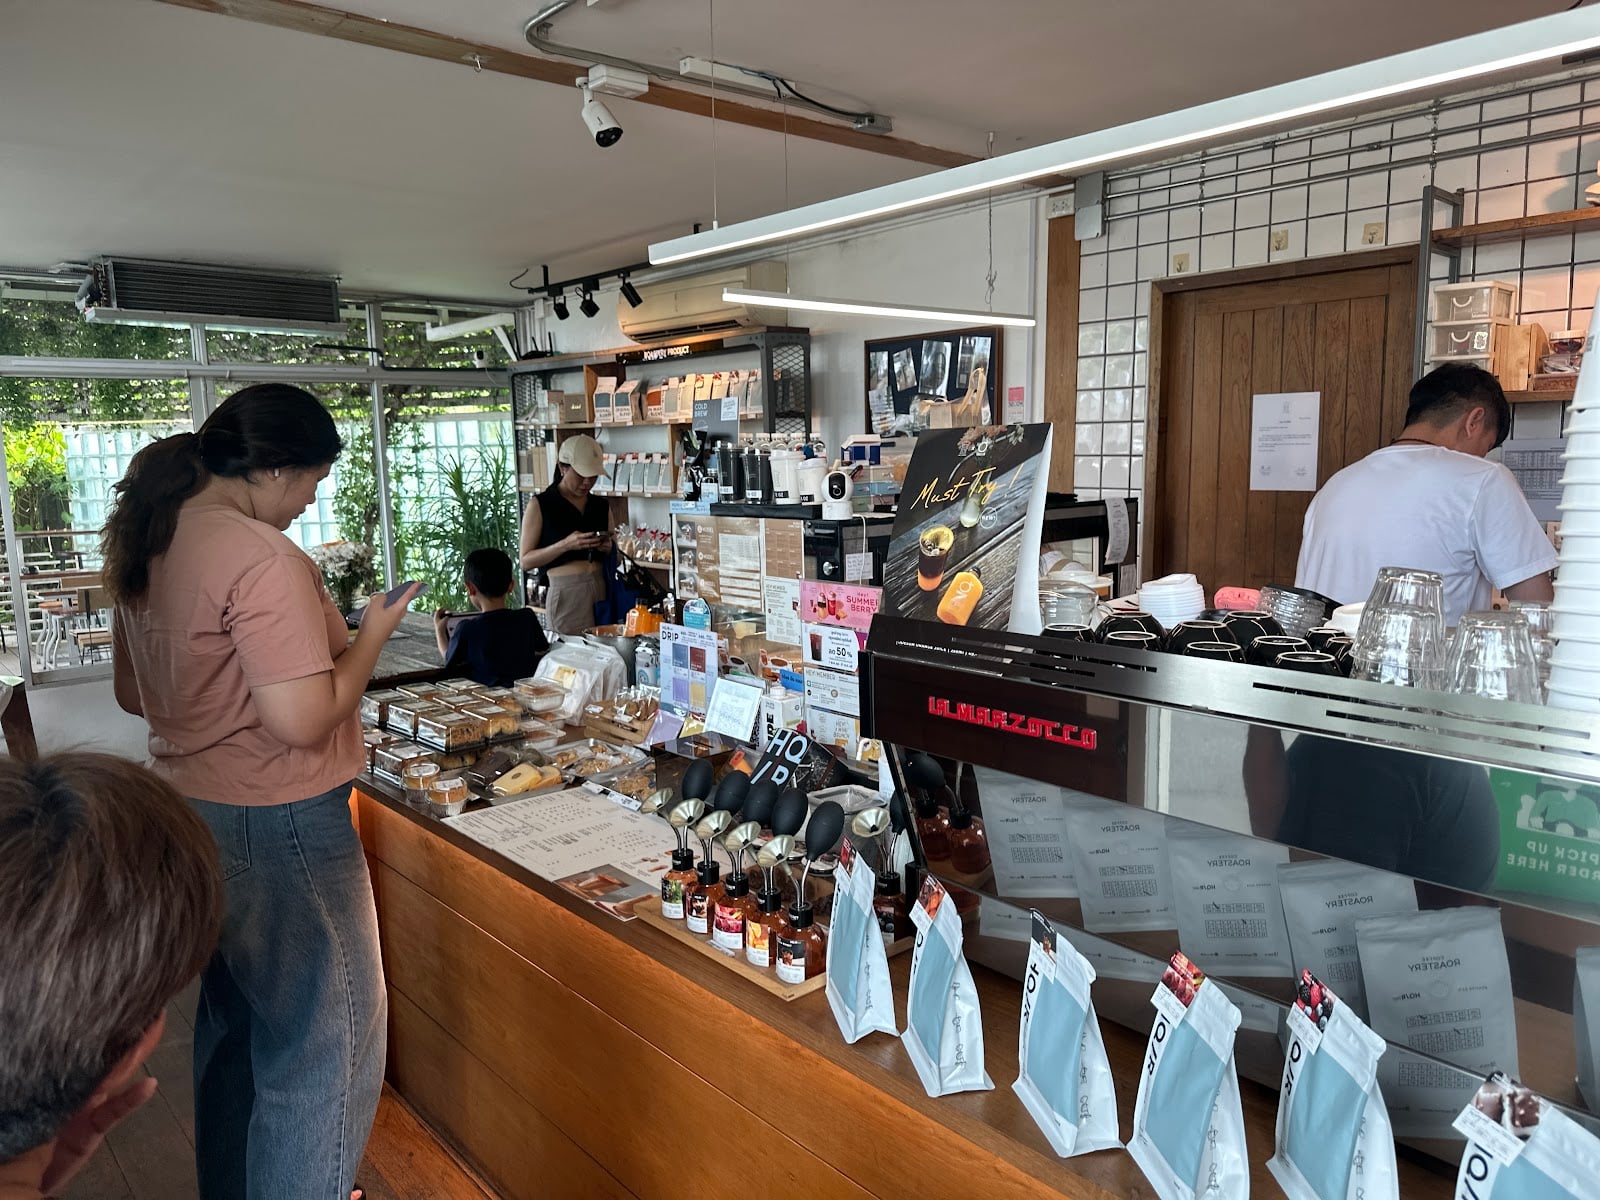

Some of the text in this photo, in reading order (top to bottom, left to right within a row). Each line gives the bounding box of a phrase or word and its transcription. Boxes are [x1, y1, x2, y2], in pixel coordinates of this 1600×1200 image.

[694, 403, 708, 411] COLD
[910, 477, 970, 509] Must
[661, 630, 679, 641] DRIP
[836, 646, 847, 657] 50
